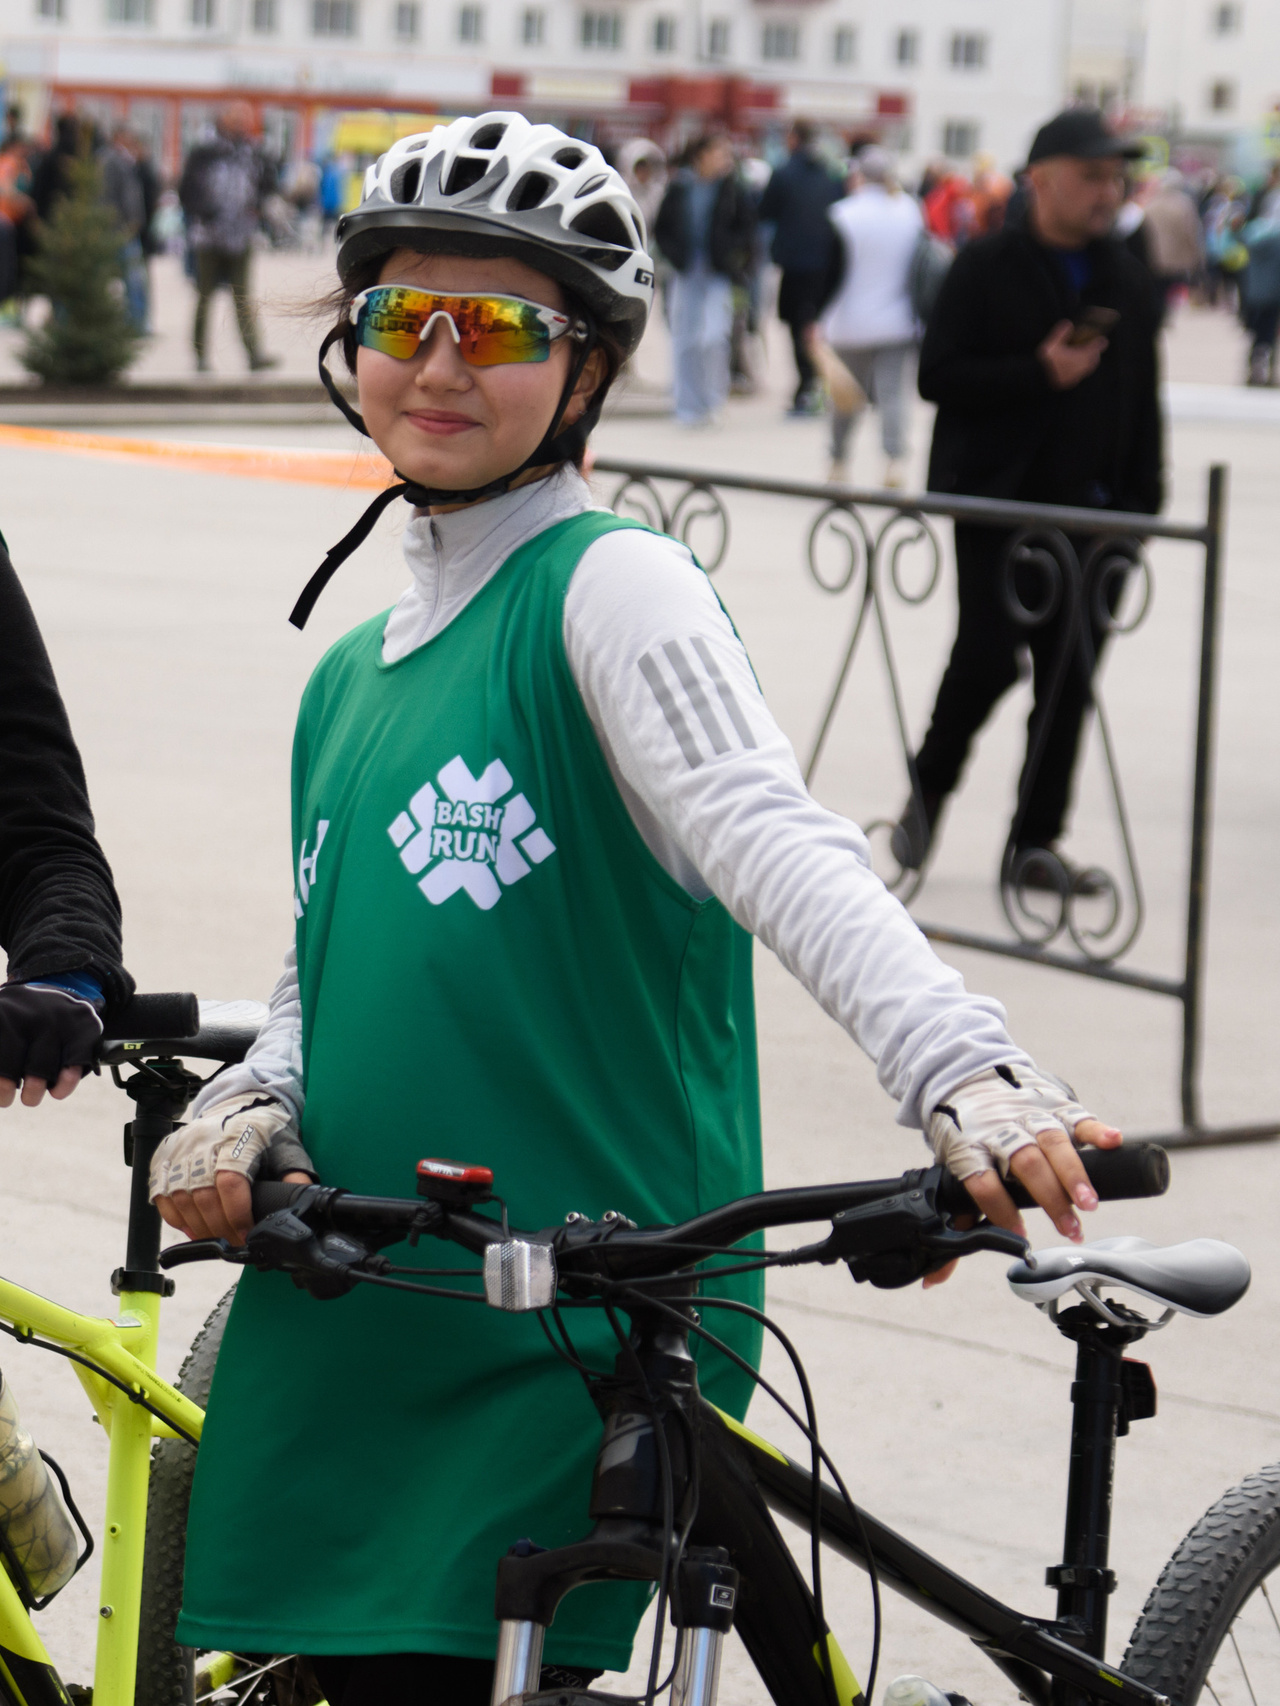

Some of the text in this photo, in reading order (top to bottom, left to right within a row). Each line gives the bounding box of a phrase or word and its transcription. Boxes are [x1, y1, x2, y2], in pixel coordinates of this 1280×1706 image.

[436, 801, 503, 829] BASH
[431, 828, 498, 862] RUN
[123, 1041, 145, 1051] GT
